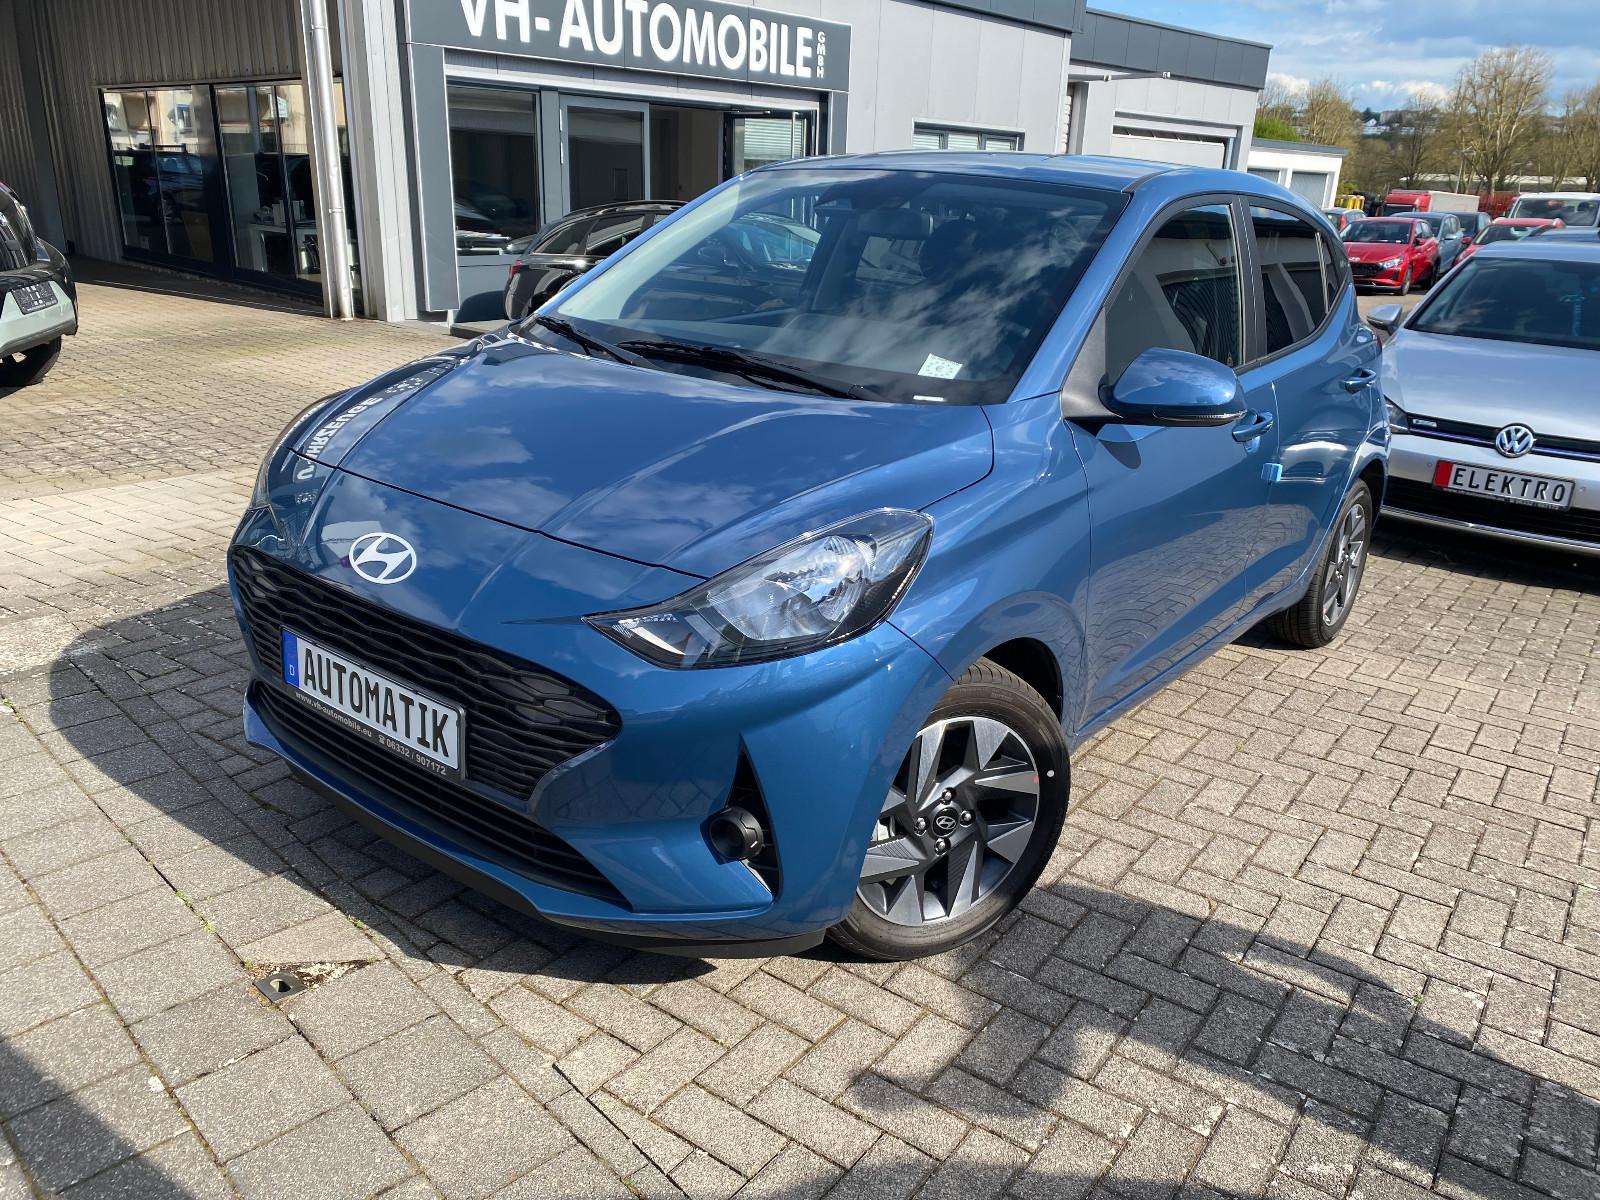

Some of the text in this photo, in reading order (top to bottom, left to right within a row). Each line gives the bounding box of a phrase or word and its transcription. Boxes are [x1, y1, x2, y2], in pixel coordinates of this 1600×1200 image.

[559, 0, 813, 79] AUTOMOBILE
[816, 31, 826, 78] GMBH
[1452, 467, 1566, 502] ELEKTRO
[289, 663, 295, 676] D
[295, 691, 372, 738] www.vh-automobile.eu
[416, 753, 447, 776] 907172
[303, 647, 449, 757] AUTOMATIK
